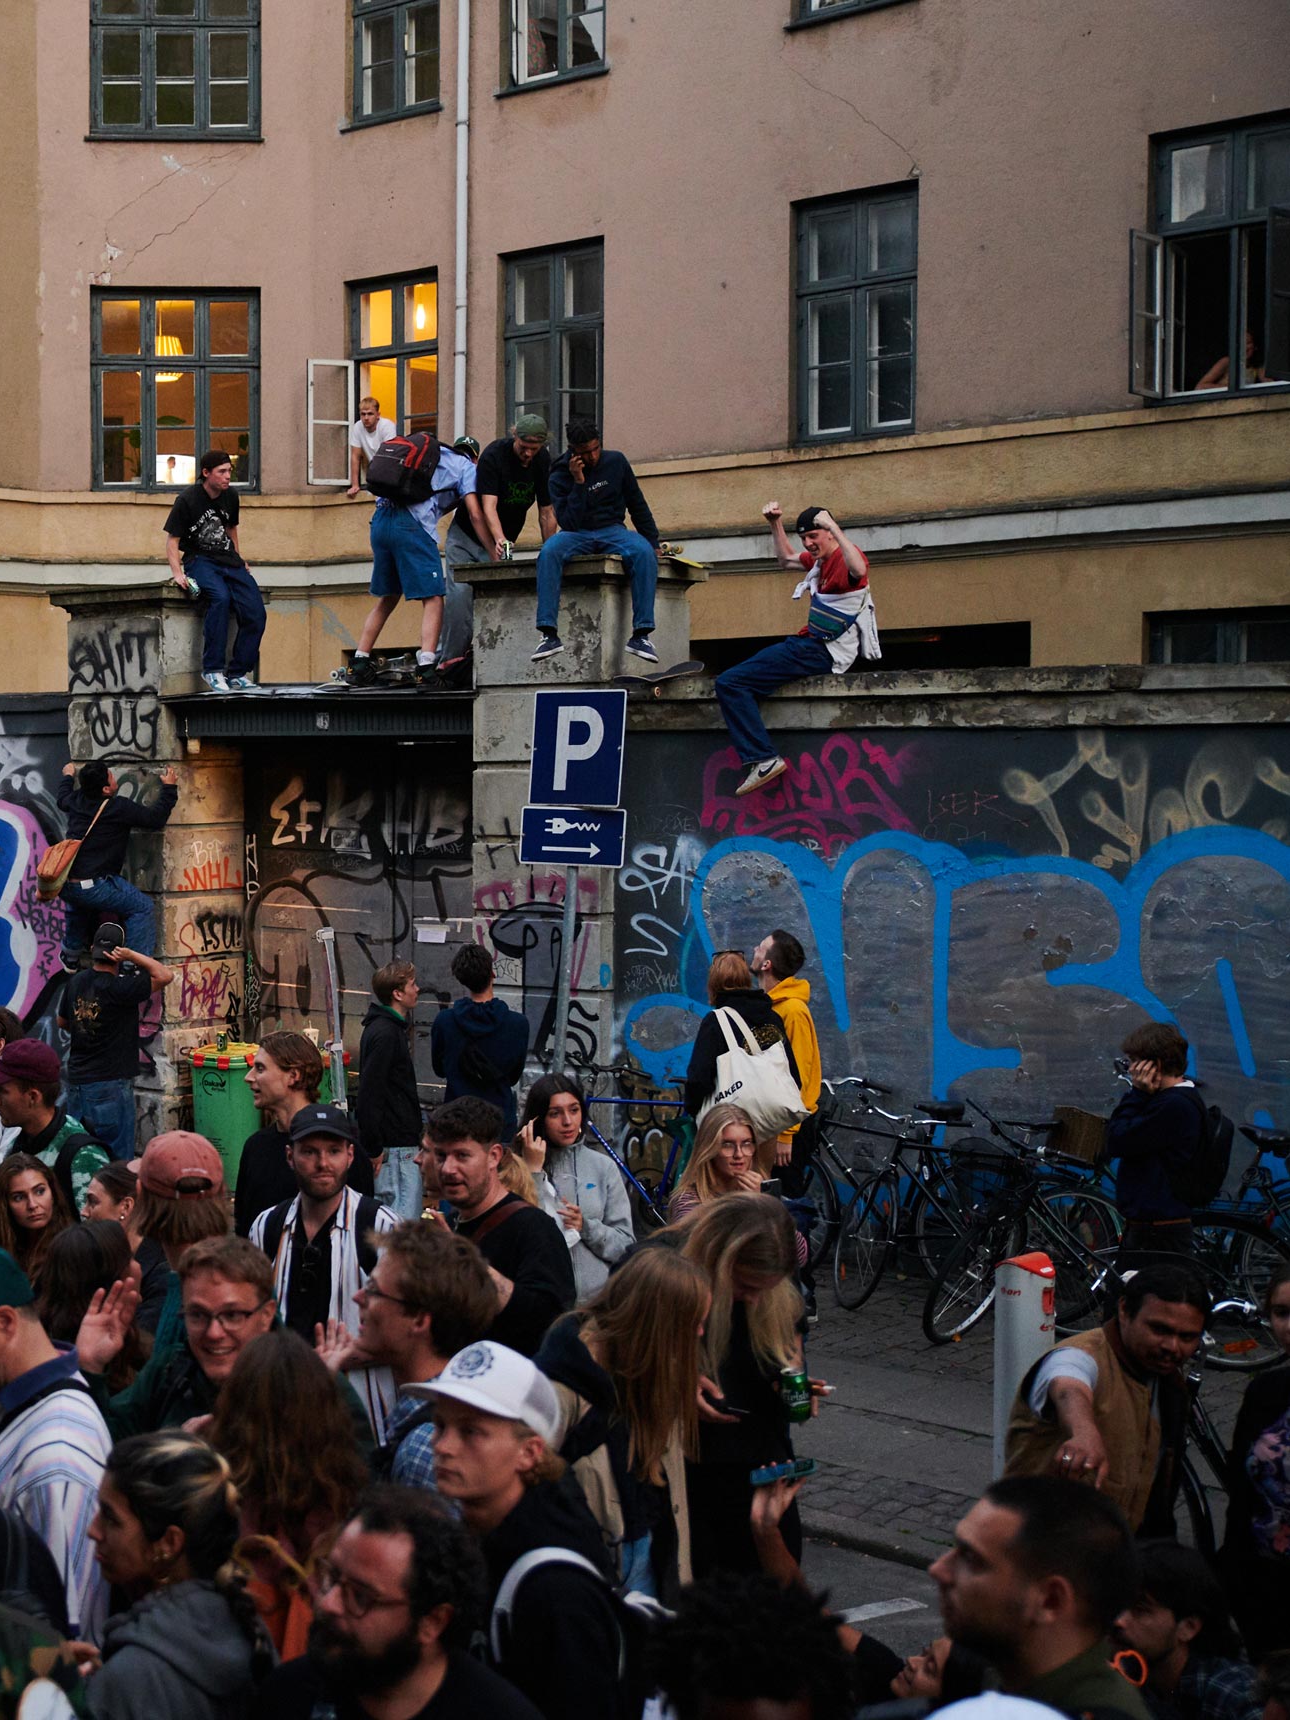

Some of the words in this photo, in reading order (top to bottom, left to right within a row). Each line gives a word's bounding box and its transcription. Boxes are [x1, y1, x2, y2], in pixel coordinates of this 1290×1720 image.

[69, 631, 163, 694] SHIT
[553, 705, 605, 791] P
[714, 1080, 743, 1105] NAKED
